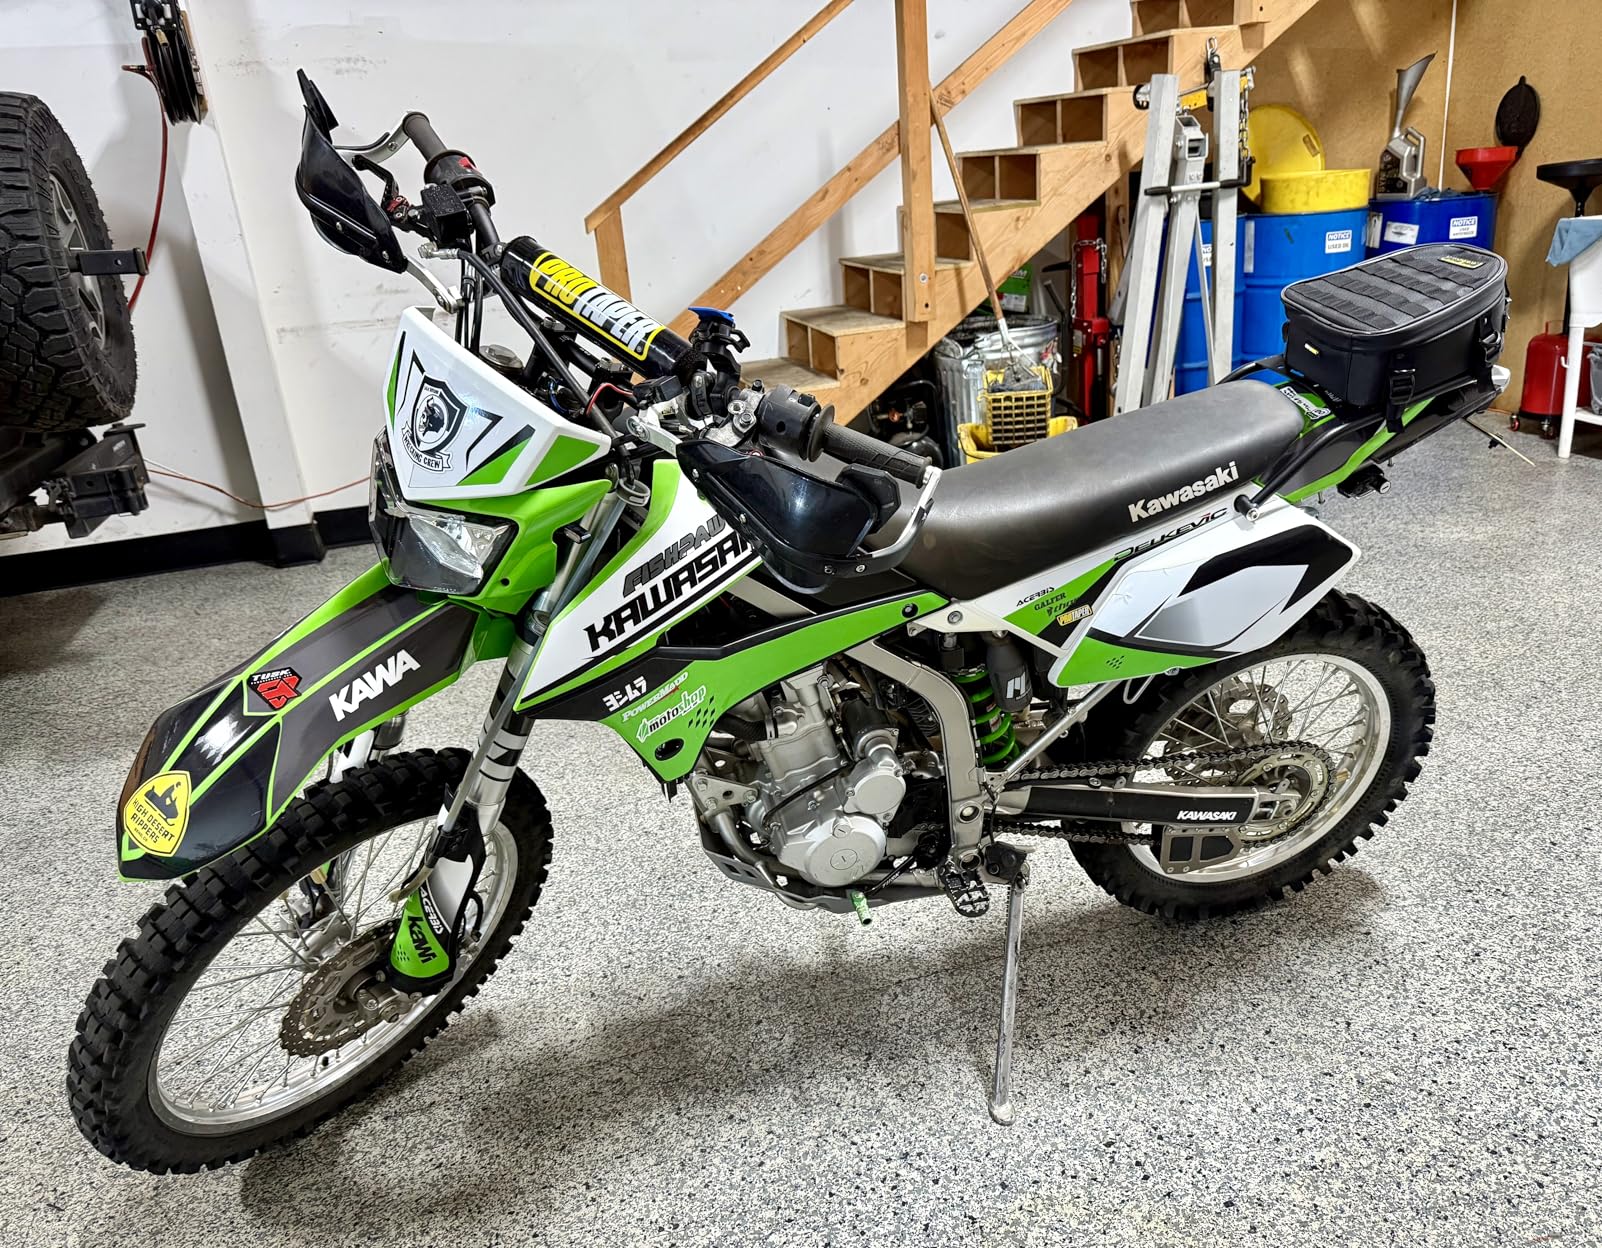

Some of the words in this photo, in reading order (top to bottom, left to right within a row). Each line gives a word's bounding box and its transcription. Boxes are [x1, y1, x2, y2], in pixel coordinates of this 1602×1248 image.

[1328, 232, 1350, 240] NOTICE
[1452, 218, 1476, 227] NOTICE
[536, 258, 663, 352] PROTAPER
[423, 457, 440, 469] CREW
[1127, 461, 1240, 523] Kawasaki
[1114, 507, 1228, 562] DELKEVIC
[1034, 592, 1066, 611] GALFER
[252, 669, 291, 681] TUSK
[328, 649, 421, 722] KAWA
[602, 676, 647, 712] ヨシムラ
[648, 685, 706, 733] motoshop
[131, 813, 160, 843] RIPPERS
[132, 798, 149, 817] HIGH
[147, 815, 175, 841] DESERT
[1177, 810, 1237, 821] KAWASAKI
